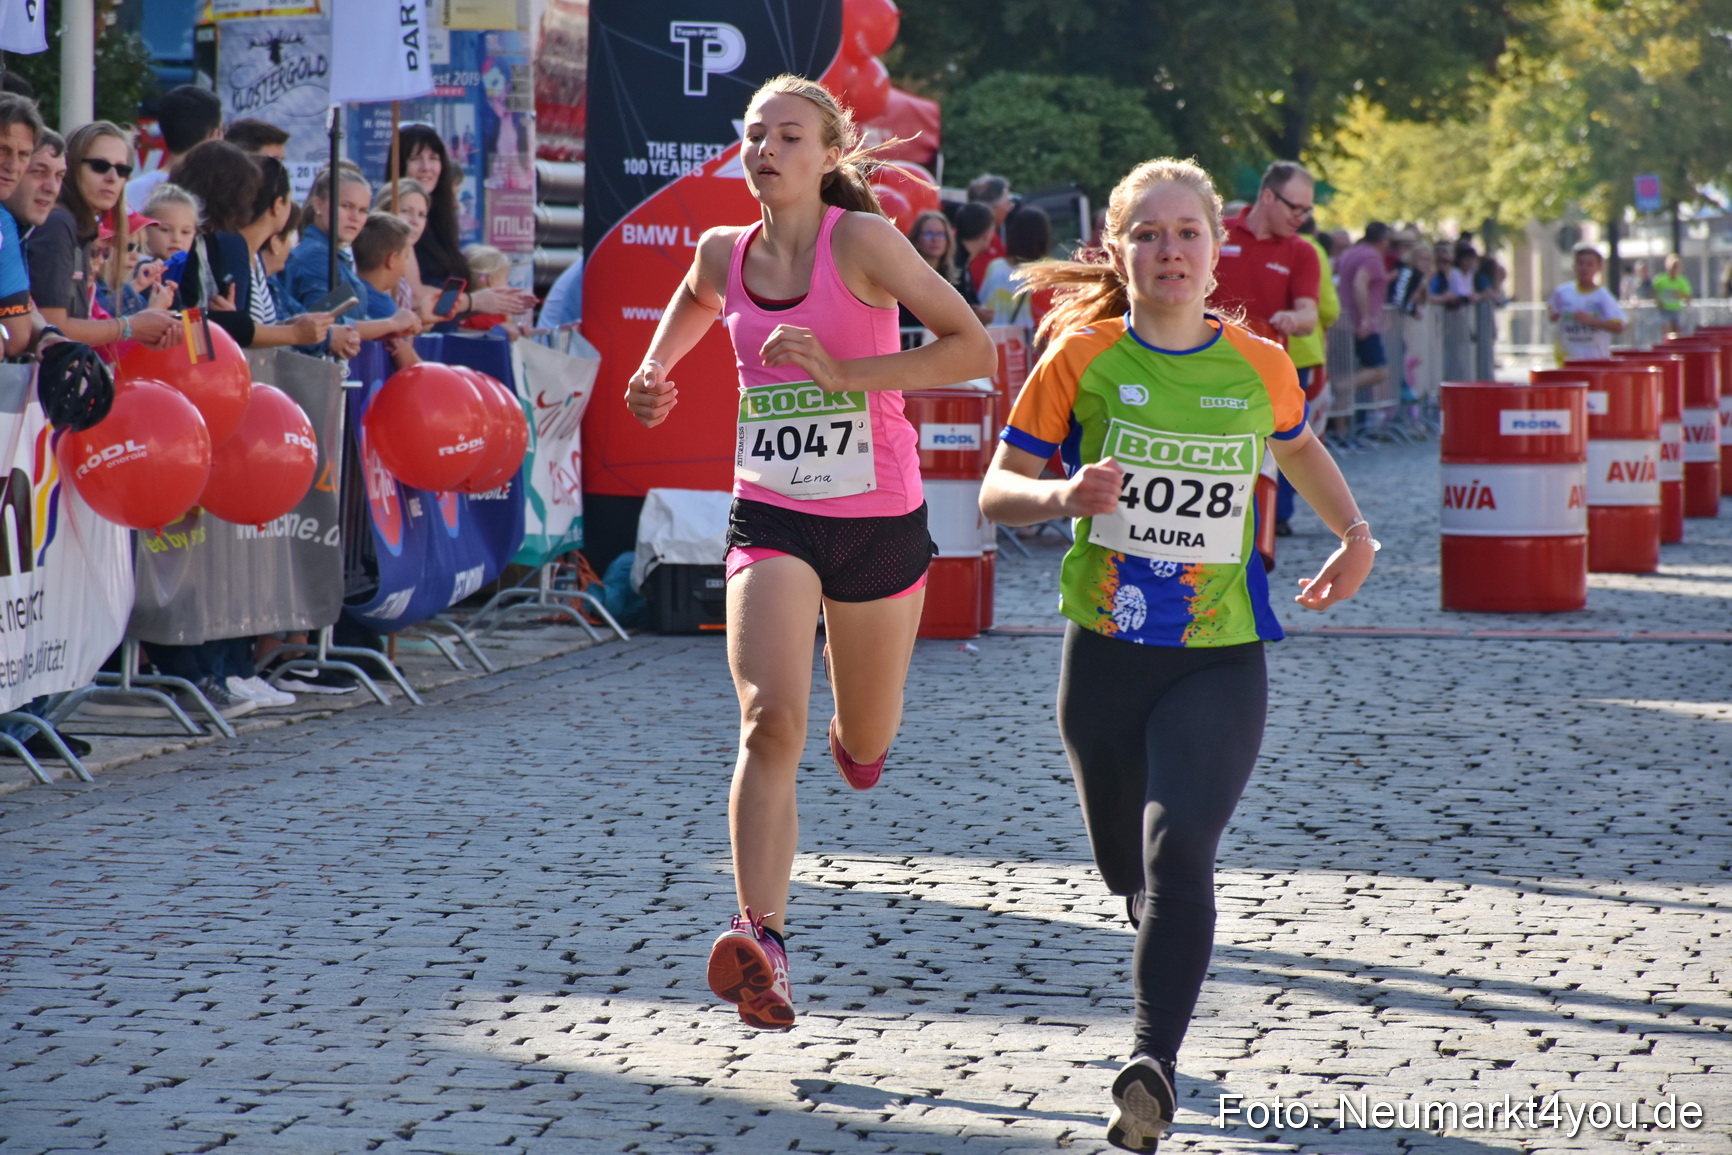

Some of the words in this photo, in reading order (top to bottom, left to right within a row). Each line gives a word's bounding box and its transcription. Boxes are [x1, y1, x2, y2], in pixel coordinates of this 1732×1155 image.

[232, 53, 329, 113] KLOSTERGOLD
[453, 70, 481, 87] 2019
[647, 141, 678, 160] THE
[680, 143, 726, 161] NEXT
[623, 158, 649, 176] 100
[650, 160, 705, 178] YEARS
[622, 223, 678, 246] BMW
[683, 226, 701, 248] L
[747, 386, 857, 418] BOCK
[1201, 396, 1249, 409] BOCK
[438, 434, 485, 457] RÖDL
[751, 420, 853, 462] 4047
[1114, 428, 1245, 471] BOCK
[75, 440, 147, 480] RÖDL
[106, 449, 148, 469] energie
[790, 466, 833, 485] Lena
[1118, 472, 1235, 519] 4028
[1129, 524, 1206, 548] LAURA
